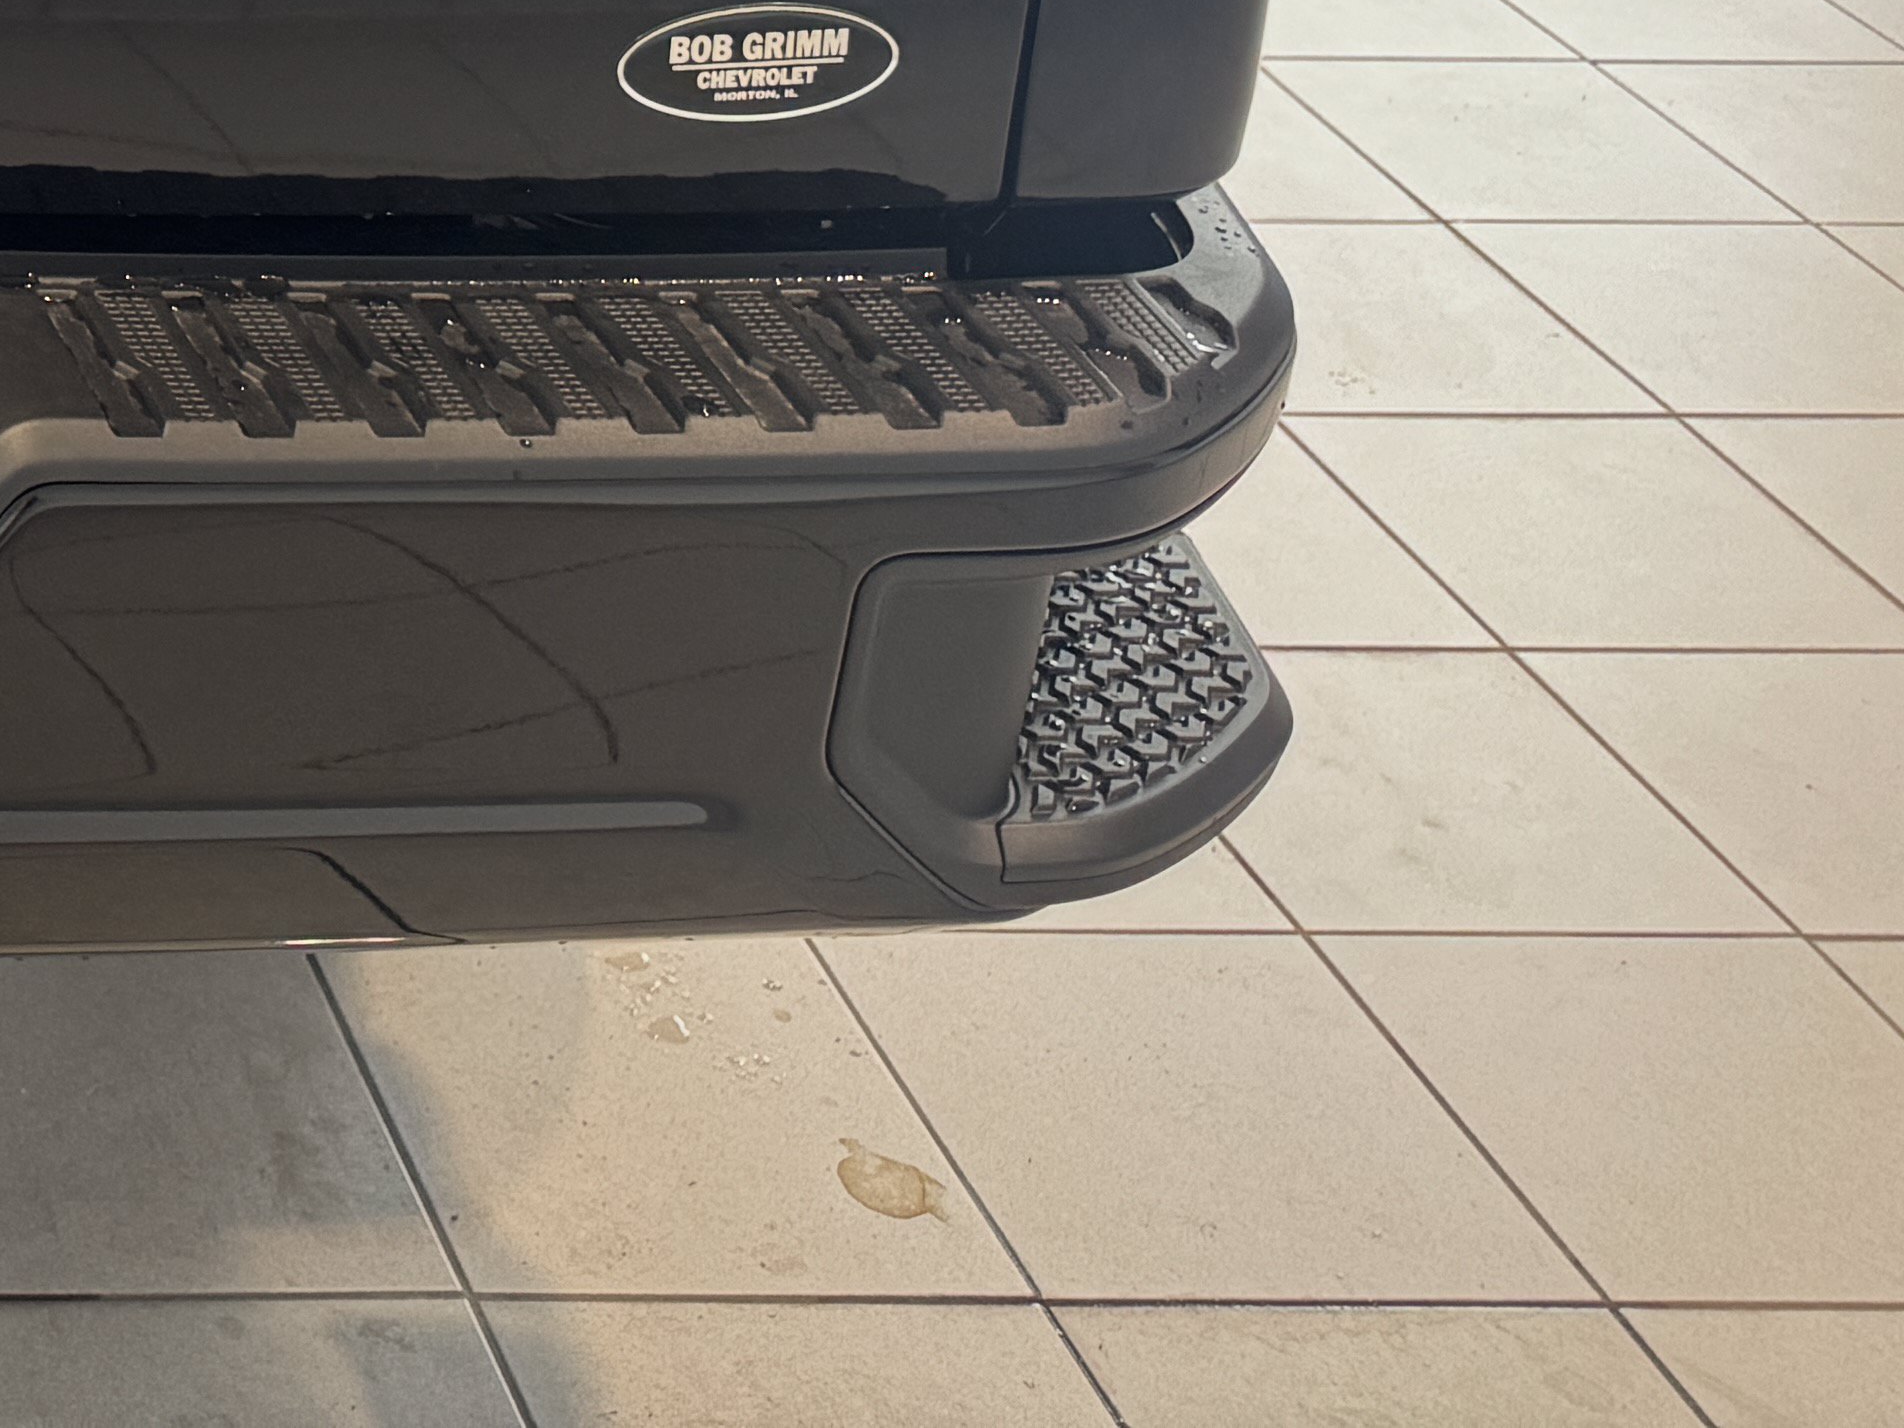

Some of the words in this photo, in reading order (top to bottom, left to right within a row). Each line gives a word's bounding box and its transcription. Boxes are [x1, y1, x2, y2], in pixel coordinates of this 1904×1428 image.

[669, 33, 734, 65] BOB
[742, 28, 850, 61] GRIMM
[696, 65, 818, 90] CHEVROLET
[713, 89, 781, 102] MORTON,
